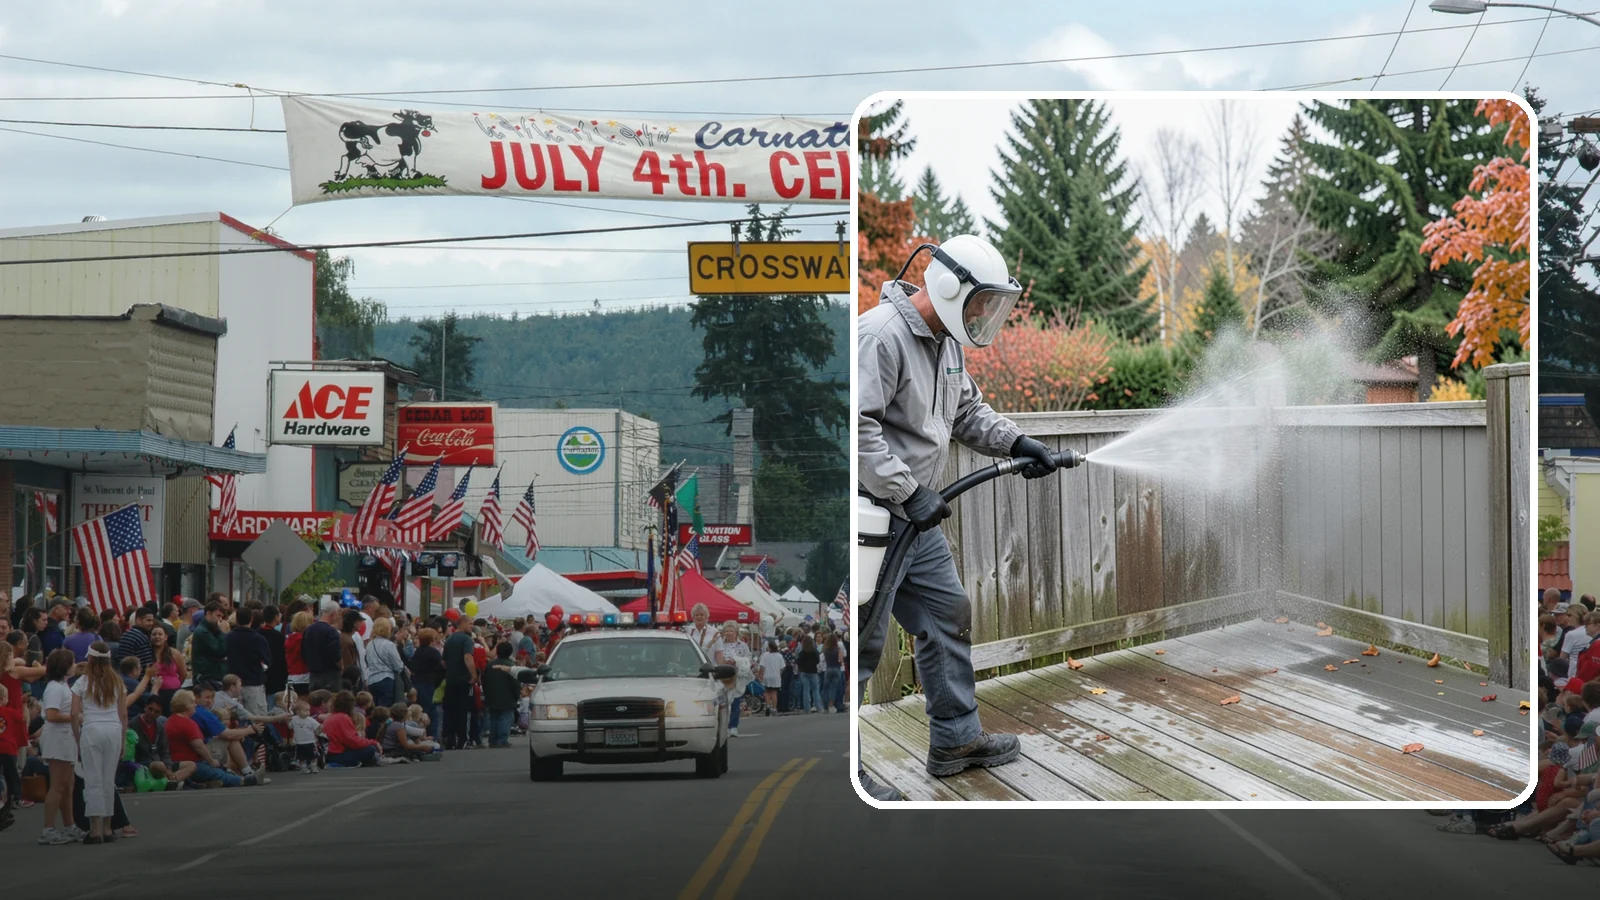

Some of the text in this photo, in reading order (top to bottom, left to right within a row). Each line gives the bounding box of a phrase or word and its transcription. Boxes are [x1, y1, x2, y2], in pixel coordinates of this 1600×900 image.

[481, 141, 604, 192] JULY
[632, 150, 747, 198] 4th.
[697, 254, 850, 280] CROSSWA
[282, 380, 373, 420] ACE
[406, 409, 485, 422] CEDAR LOG
[283, 421, 371, 436] Hardware
[353, 468, 388, 481] Simpl
[83, 485, 155, 495] St. Vincent de Paul
[212, 516, 330, 535] HARDARE
[688, 526, 741, 535] CRNATION
[699, 535, 730, 543] GLASS
